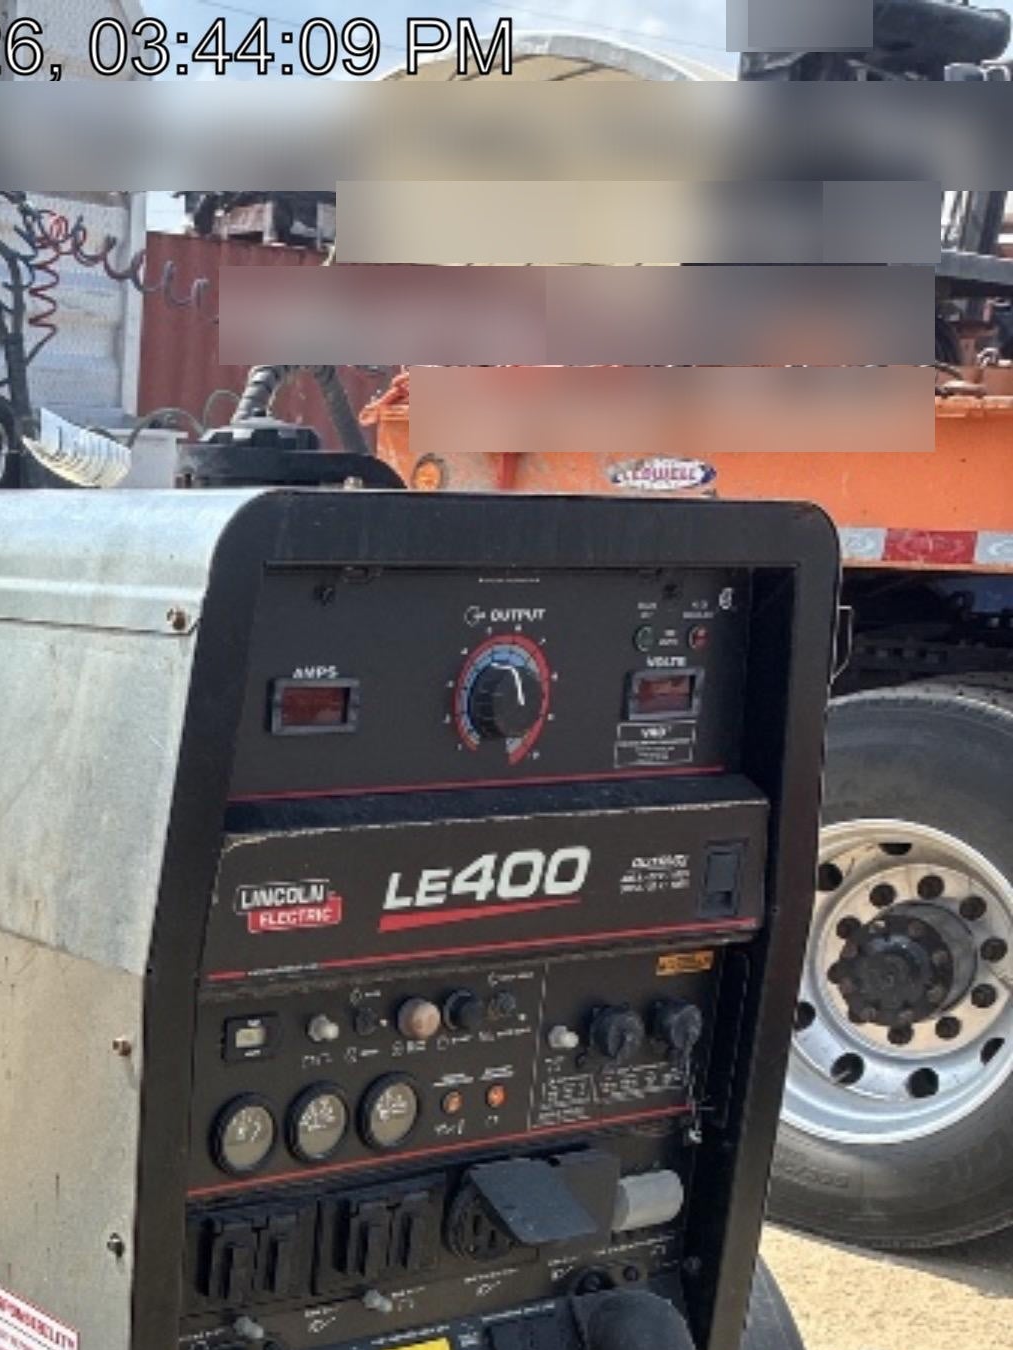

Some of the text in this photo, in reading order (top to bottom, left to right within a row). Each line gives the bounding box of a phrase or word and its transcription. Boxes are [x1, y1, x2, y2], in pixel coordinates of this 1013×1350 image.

[490, 608, 546, 622] OUTPUT
[292, 665, 339, 679] AMPS
[383, 846, 591, 910] LE400
[241, 884, 324, 910] LINCOLN
[259, 908, 333, 927] ELECTRIC
